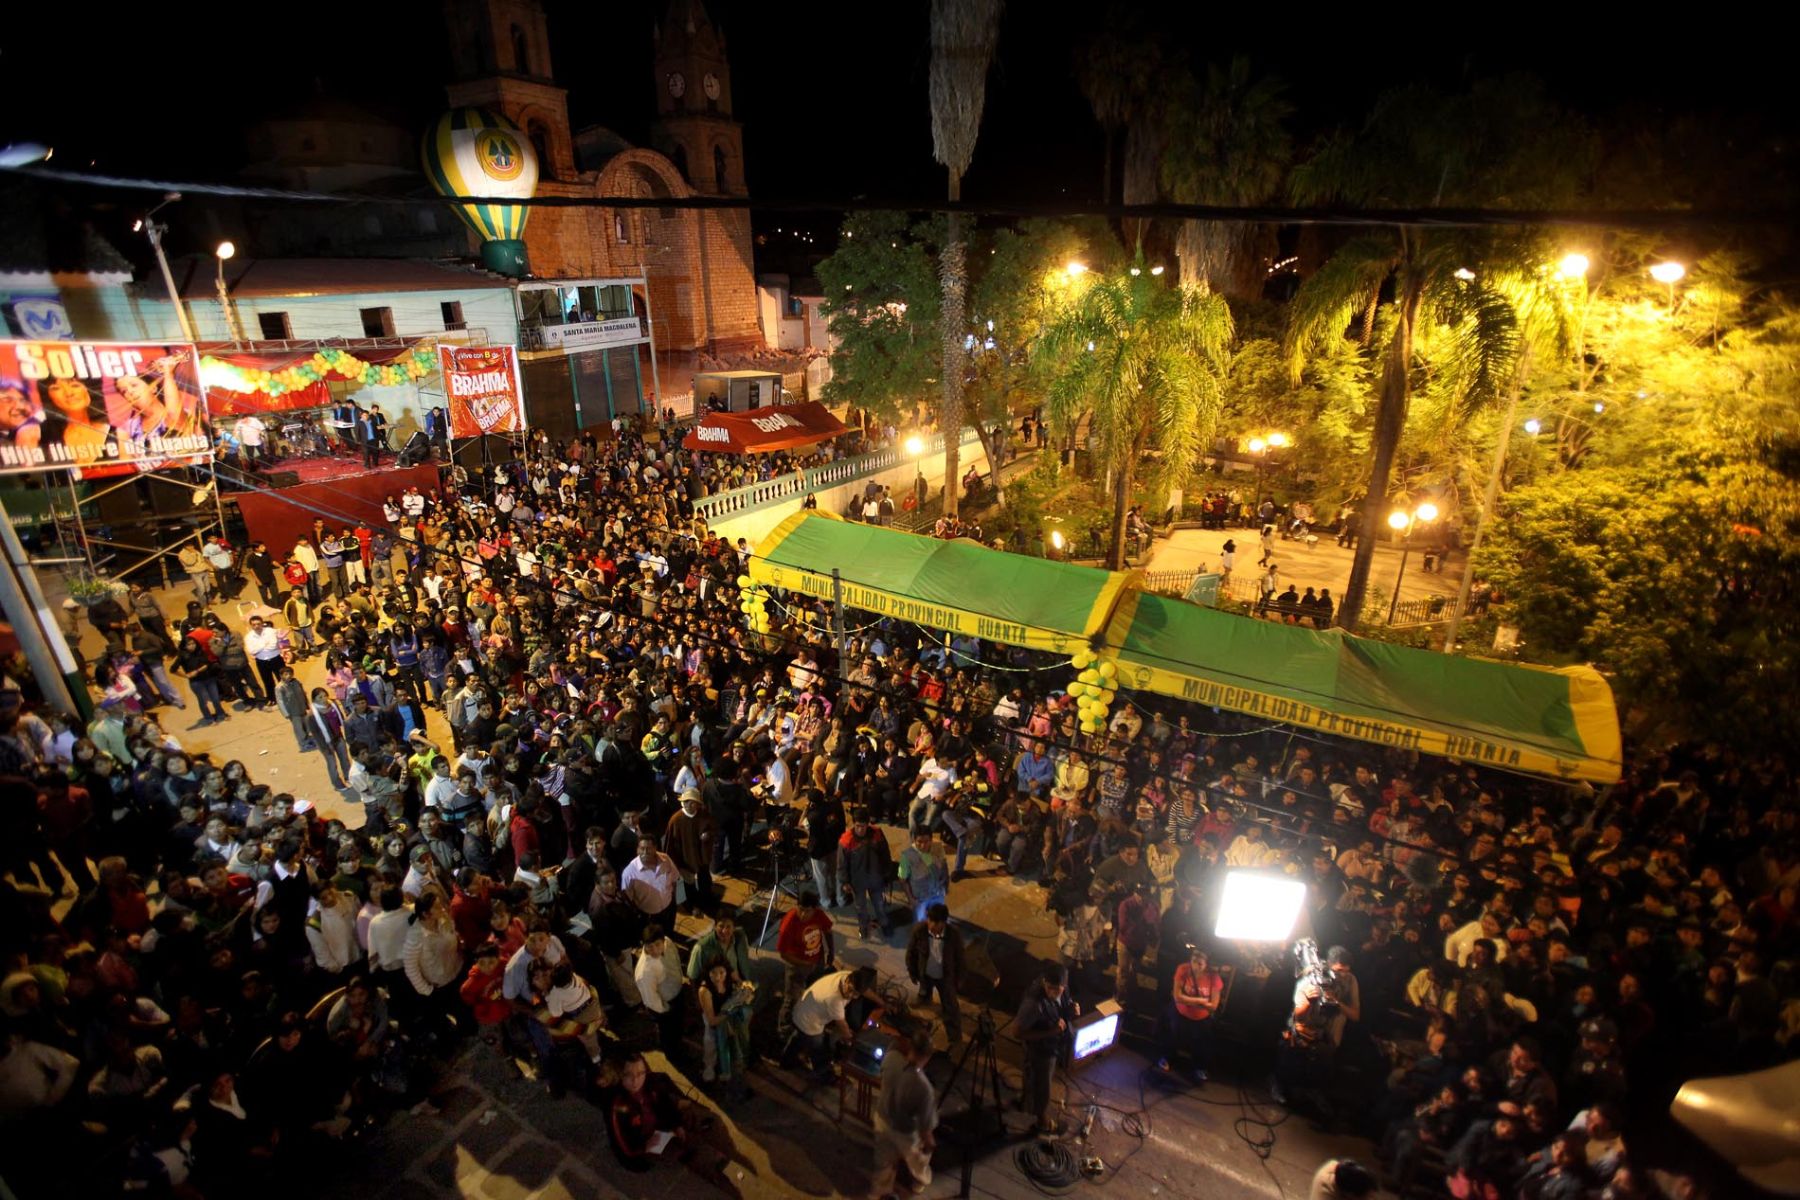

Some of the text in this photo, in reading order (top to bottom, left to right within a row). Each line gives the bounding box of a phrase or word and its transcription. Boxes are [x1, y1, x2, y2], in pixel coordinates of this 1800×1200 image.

[563, 328, 583, 336] SANTA
[15, 344, 143, 379] Solier
[451, 371, 511, 396] BRAHMA
[479, 399, 512, 430] BRAHMA
[697, 425, 730, 443] BRAHMA
[0, 446, 45, 467] Hija
[49, 441, 119, 461] ilustre
[151, 434, 209, 452] Huanta
[801, 575, 1026, 643] MUNICPALIDAD PROVINCIAL HUANTA
[1182, 678, 1311, 723] MUNICIPALIDAD
[1317, 710, 1423, 751] PROVINCIAL
